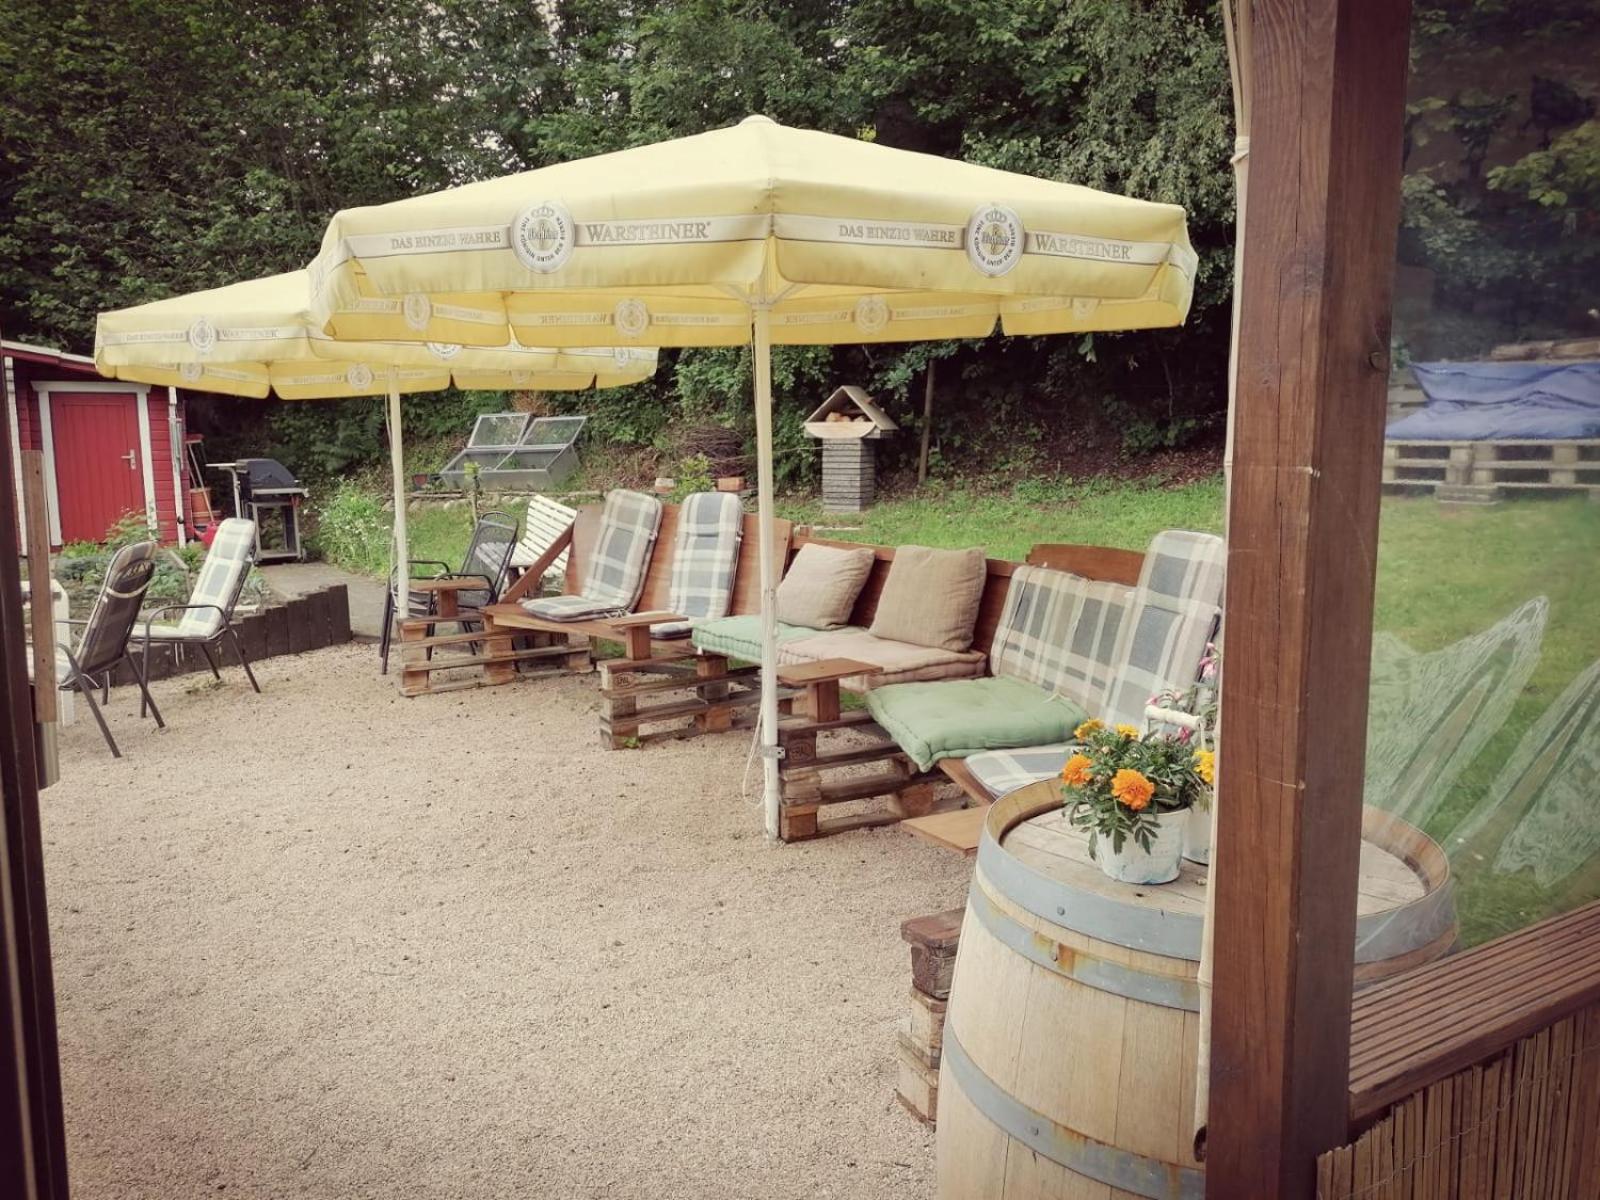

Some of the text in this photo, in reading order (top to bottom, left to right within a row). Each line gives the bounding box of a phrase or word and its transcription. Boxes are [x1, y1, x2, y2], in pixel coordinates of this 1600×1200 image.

[391, 238, 413, 249] DAS
[458, 231, 501, 245] WAHRE
[585, 221, 710, 242] WARSTEINER
[839, 225, 955, 243] DAS EINZIG WAHRE
[1035, 233, 1132, 260] WARSTEINER
